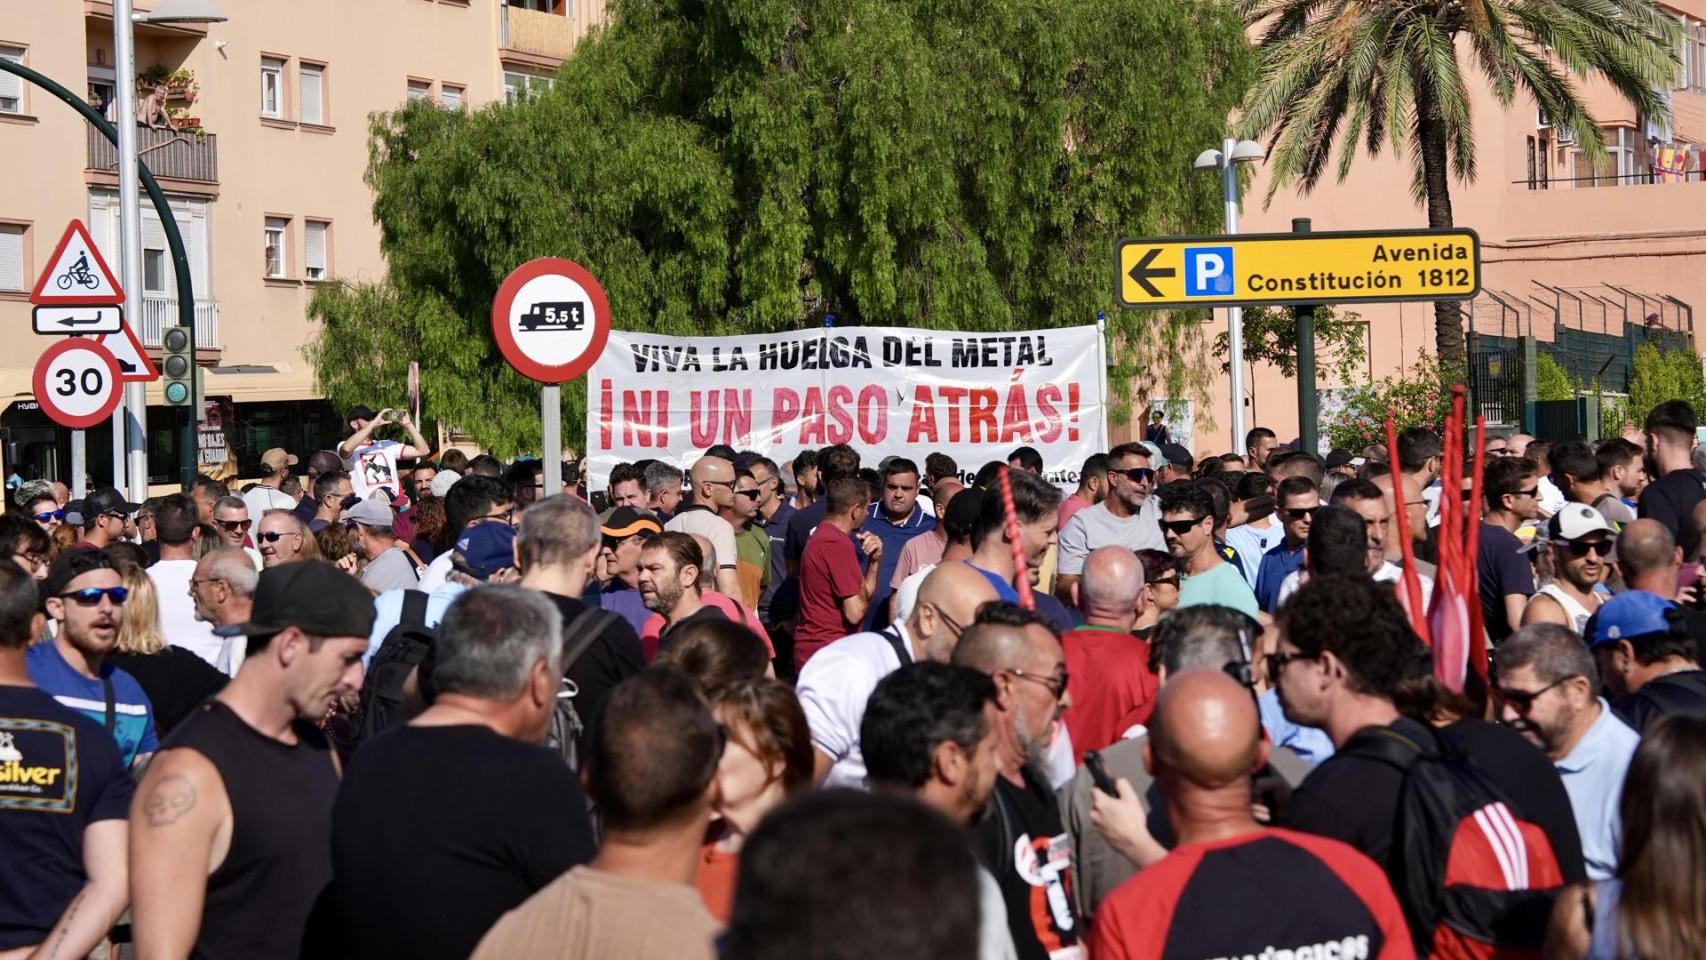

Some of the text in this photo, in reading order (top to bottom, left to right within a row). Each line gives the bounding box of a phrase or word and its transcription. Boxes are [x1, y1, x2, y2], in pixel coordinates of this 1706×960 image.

[1372, 243, 1468, 263] Avenida
[1195, 253, 1225, 291] P
[1246, 268, 1470, 293] Constitución 1812
[630, 335, 1054, 372] VIVA LA HUELGA DEL METAL
[55, 367, 103, 397] 30
[689, 387, 753, 449] UN
[771, 383, 889, 446] PASO
[906, 368, 1080, 444] ATRÁS!
